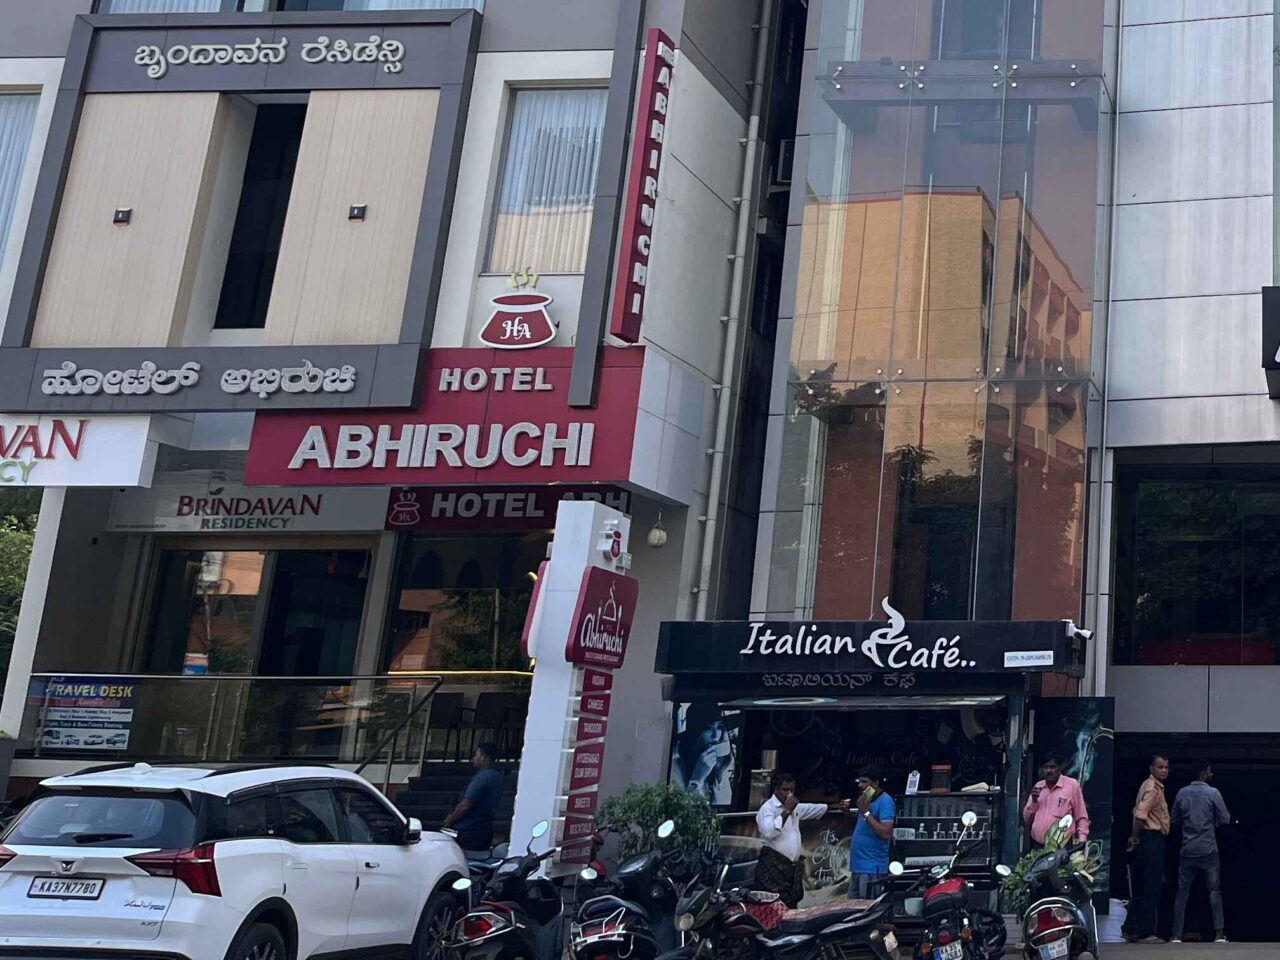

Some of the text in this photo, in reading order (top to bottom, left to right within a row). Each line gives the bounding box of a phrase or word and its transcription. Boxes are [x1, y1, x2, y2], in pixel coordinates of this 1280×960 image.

[134, 35, 405, 78] ಬೃಂದಾವನ ರೆಸಿಡೆನ್ಸಿ
[631, 66, 670, 315] ABHIRUCHI
[41, 359, 357, 400] ಹೋಟೆಲ್ ಅಭಿರುಚಿ
[439, 367, 554, 393] HOTEL
[288, 421, 596, 470] ABHIRUCHI
[177, 494, 323, 517] BRINDAVAN
[431, 492, 545, 518] HOTEL
[200, 517, 291, 530] RESIDENCY
[739, 622, 856, 655] Italian
[52, 684, 133, 697] TRAVEL DESK
